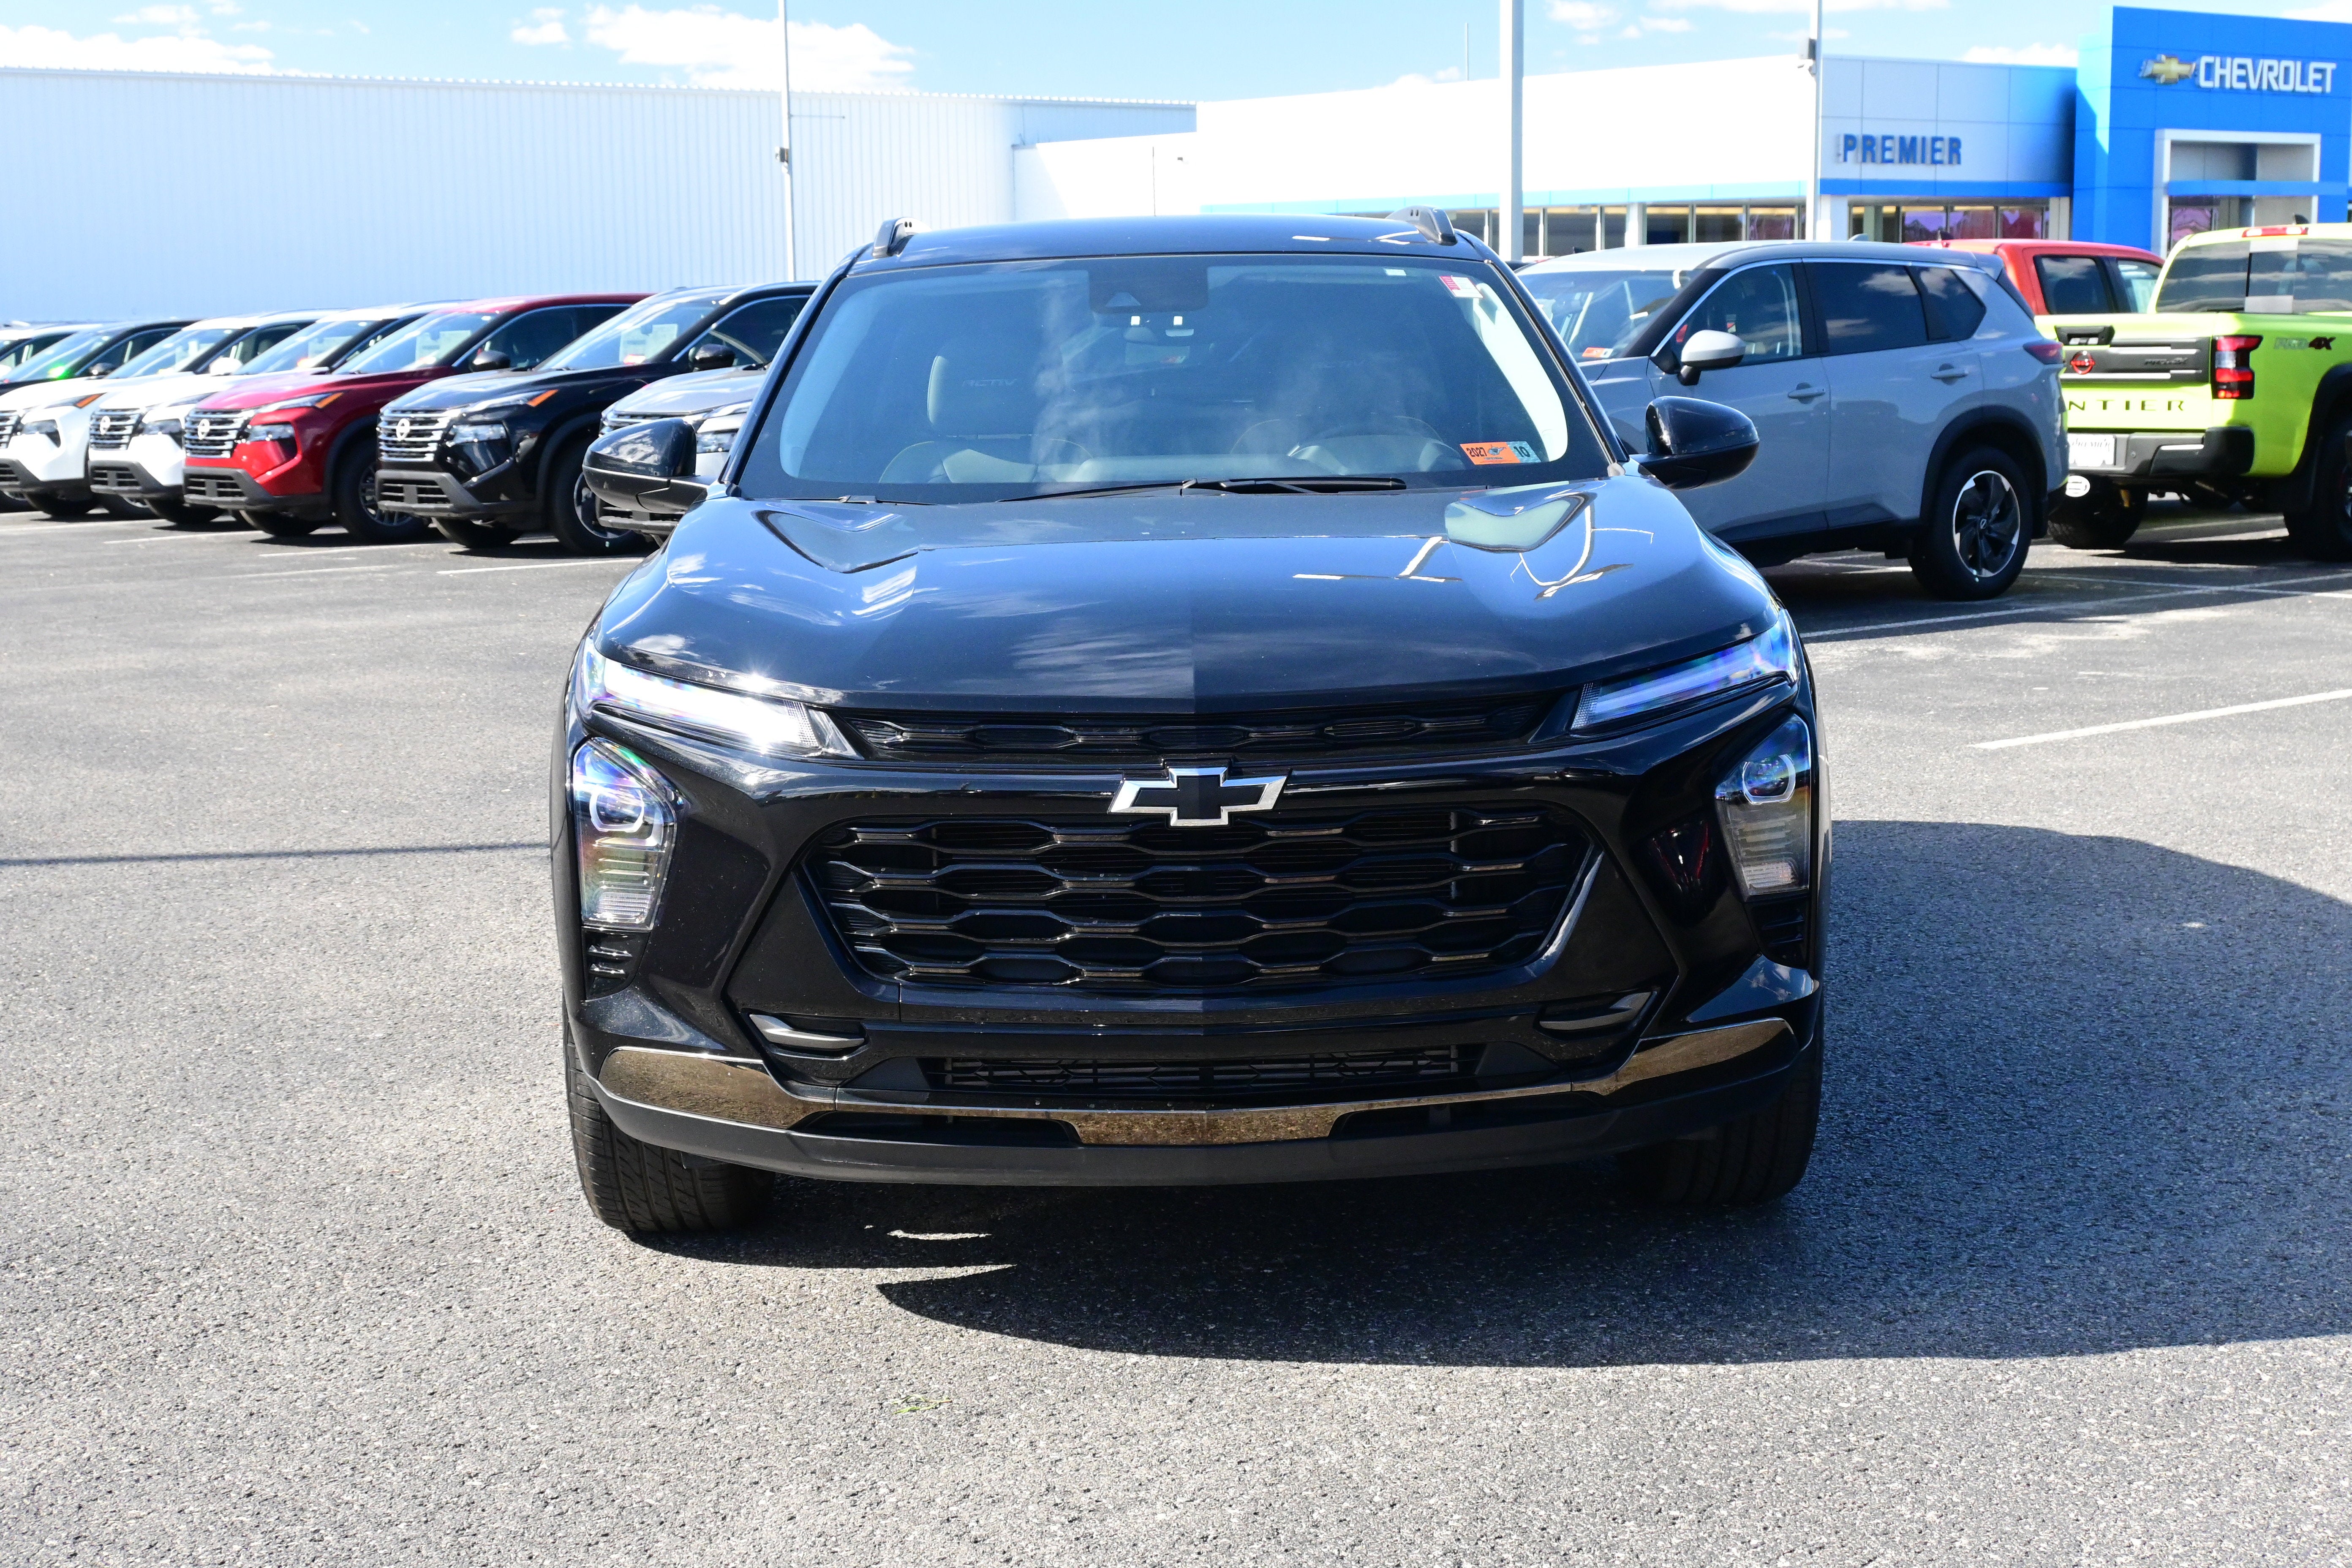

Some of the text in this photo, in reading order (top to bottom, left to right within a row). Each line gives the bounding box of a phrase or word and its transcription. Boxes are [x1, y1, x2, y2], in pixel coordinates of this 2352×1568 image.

[2199, 55, 2336, 93] CHEVROLET
[1843, 133, 1962, 164] PREMIER
[2069, 400, 2184, 411] NTIER
[1466, 446, 1531, 457] 2027 10
